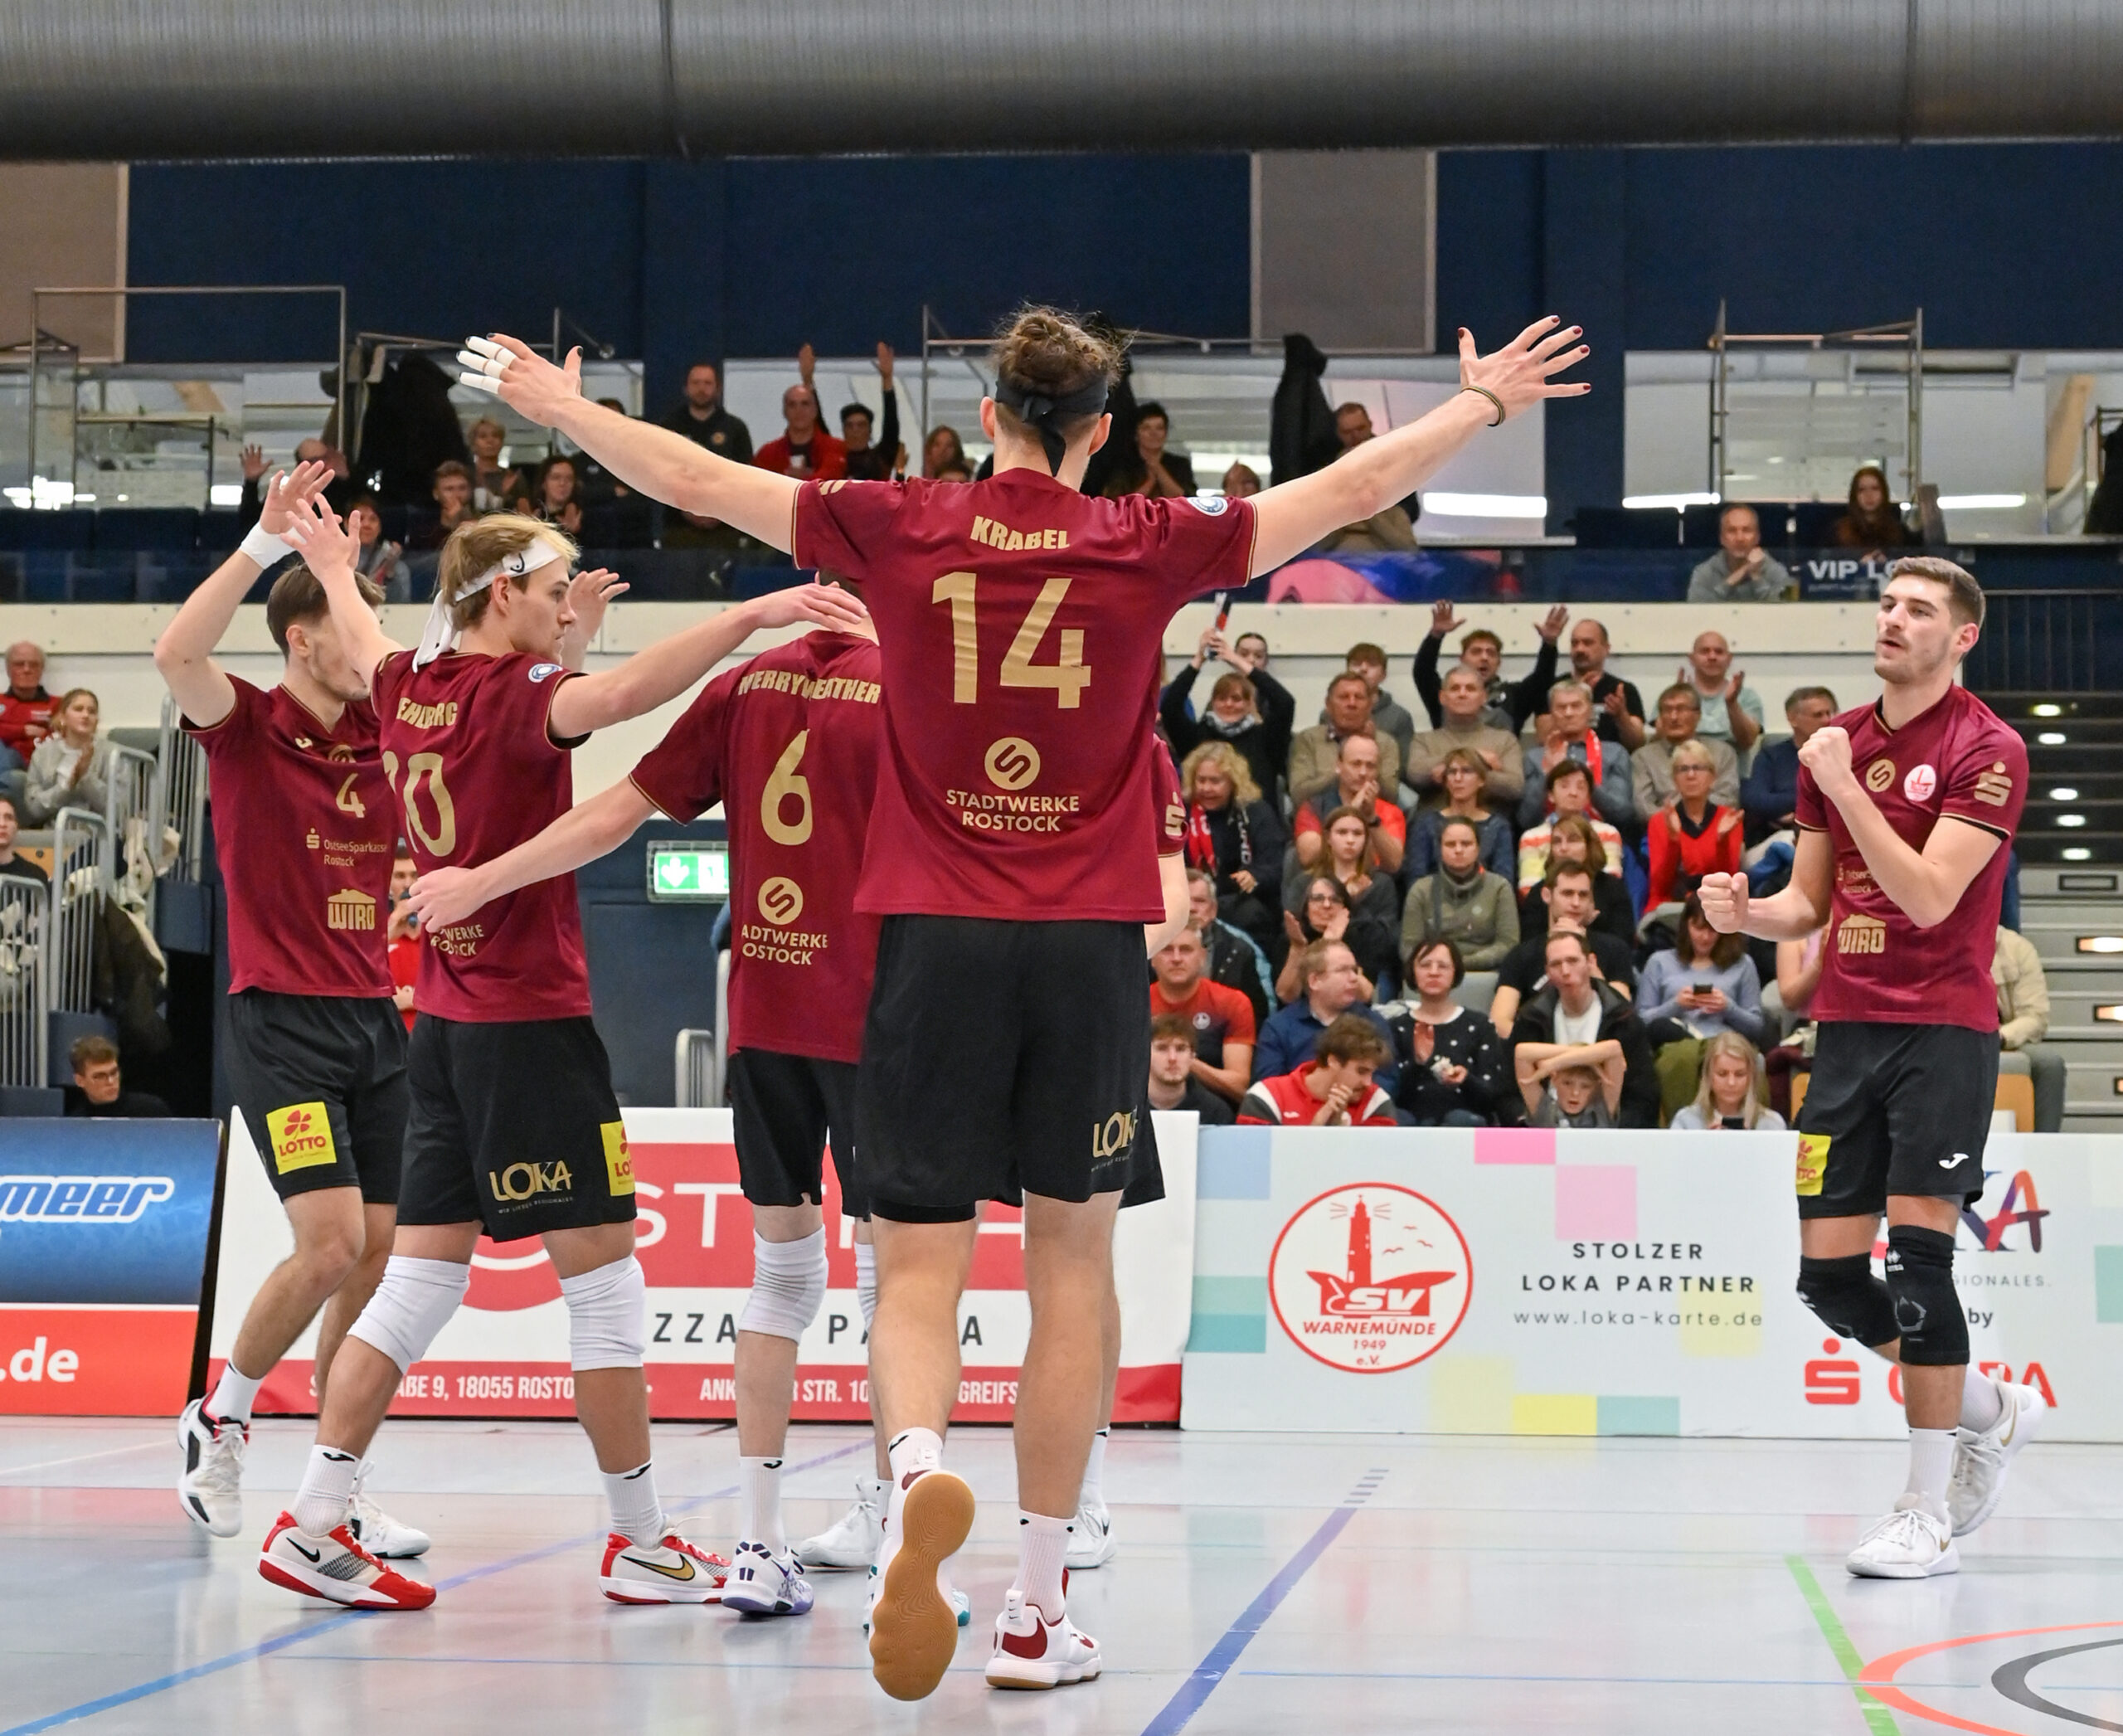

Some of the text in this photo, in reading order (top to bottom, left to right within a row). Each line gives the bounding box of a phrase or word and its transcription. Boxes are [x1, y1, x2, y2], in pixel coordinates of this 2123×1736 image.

[970, 515, 1071, 551] KRABEL
[1808, 560, 1858, 579] VIP
[932, 571, 1092, 709] 14
[336, 773, 366, 819] 4
[760, 728, 814, 846] 6
[945, 790, 1081, 813] STADTWERKE
[961, 811, 1062, 833] ROSTOCK
[328, 903, 376, 931] WIRO
[279, 1135, 327, 1157] LOTTO
[488, 1160, 573, 1202] LOKA
[1572, 1242, 1703, 1260] STOLZER
[1522, 1275, 1754, 1293] LOKA PARTNER
[1303, 1318, 1436, 1335] WARNEMÜNDE
[1513, 1310, 1762, 1326] www.loka-karte.de
[1968, 1307, 1993, 1328] by
[1353, 1340, 1387, 1351] 1949
[1356, 1355, 1380, 1366] e.V.
[432, 1375, 449, 1401] 9,
[457, 1376, 513, 1399] 18055
[517, 1376, 575, 1400] ROSTO
[802, 1379, 843, 1403] STR.
[958, 1380, 1018, 1404] GREIFS
